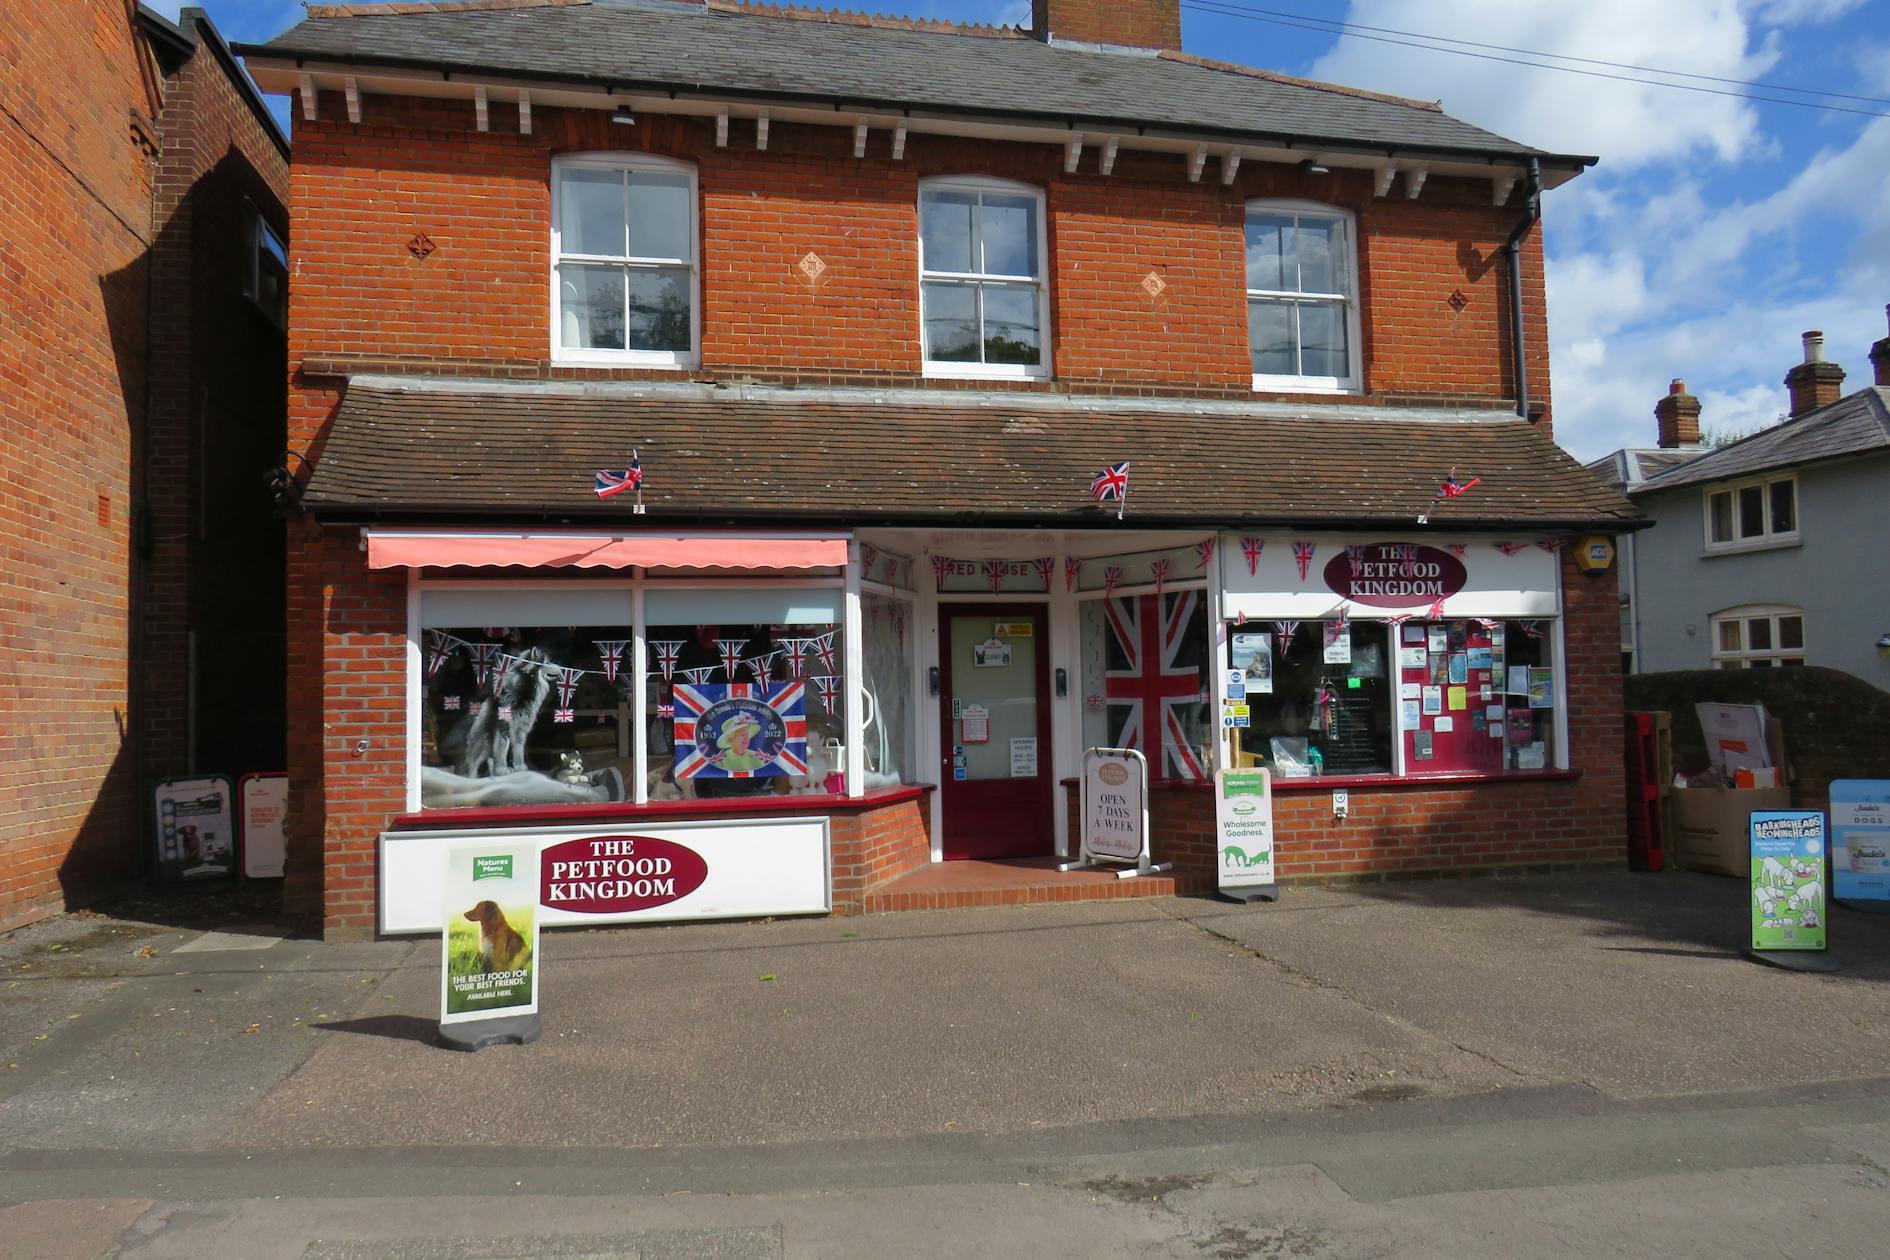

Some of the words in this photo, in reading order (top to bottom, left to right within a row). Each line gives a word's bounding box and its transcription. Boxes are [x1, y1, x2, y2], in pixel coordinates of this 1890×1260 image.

[1378, 546, 1416, 560] TH
[948, 563, 975, 576] RED
[981, 563, 1028, 577] HUSE
[1349, 580, 1443, 595] KINGDOM
[700, 731, 717, 739] 1952
[764, 730, 782, 738] 2022
[1100, 793, 1127, 806] OPEN
[1097, 805, 1103, 815] 7
[1106, 806, 1130, 819] DAYS
[1094, 817, 1101, 829] A
[1104, 818, 1133, 832] WEEK
[1223, 820, 1267, 829] Wholesome
[1225, 829, 1264, 838] Goodness.
[589, 840, 635, 857] THE
[477, 858, 509, 867] Natures
[482, 865, 504, 873] Menu
[551, 857, 672, 880] PETFOOD
[548, 878, 677, 903] KINGDOM
[452, 976, 466, 985] THE
[468, 973, 487, 983] BEST
[487, 971, 511, 981] FOOD
[512, 969, 528, 978] FOR
[454, 983, 475, 992] YOUR
[476, 980, 494, 990] BEST
[495, 977, 526, 988] FRIENDS.
[467, 991, 496, 1001] AVAILABLE
